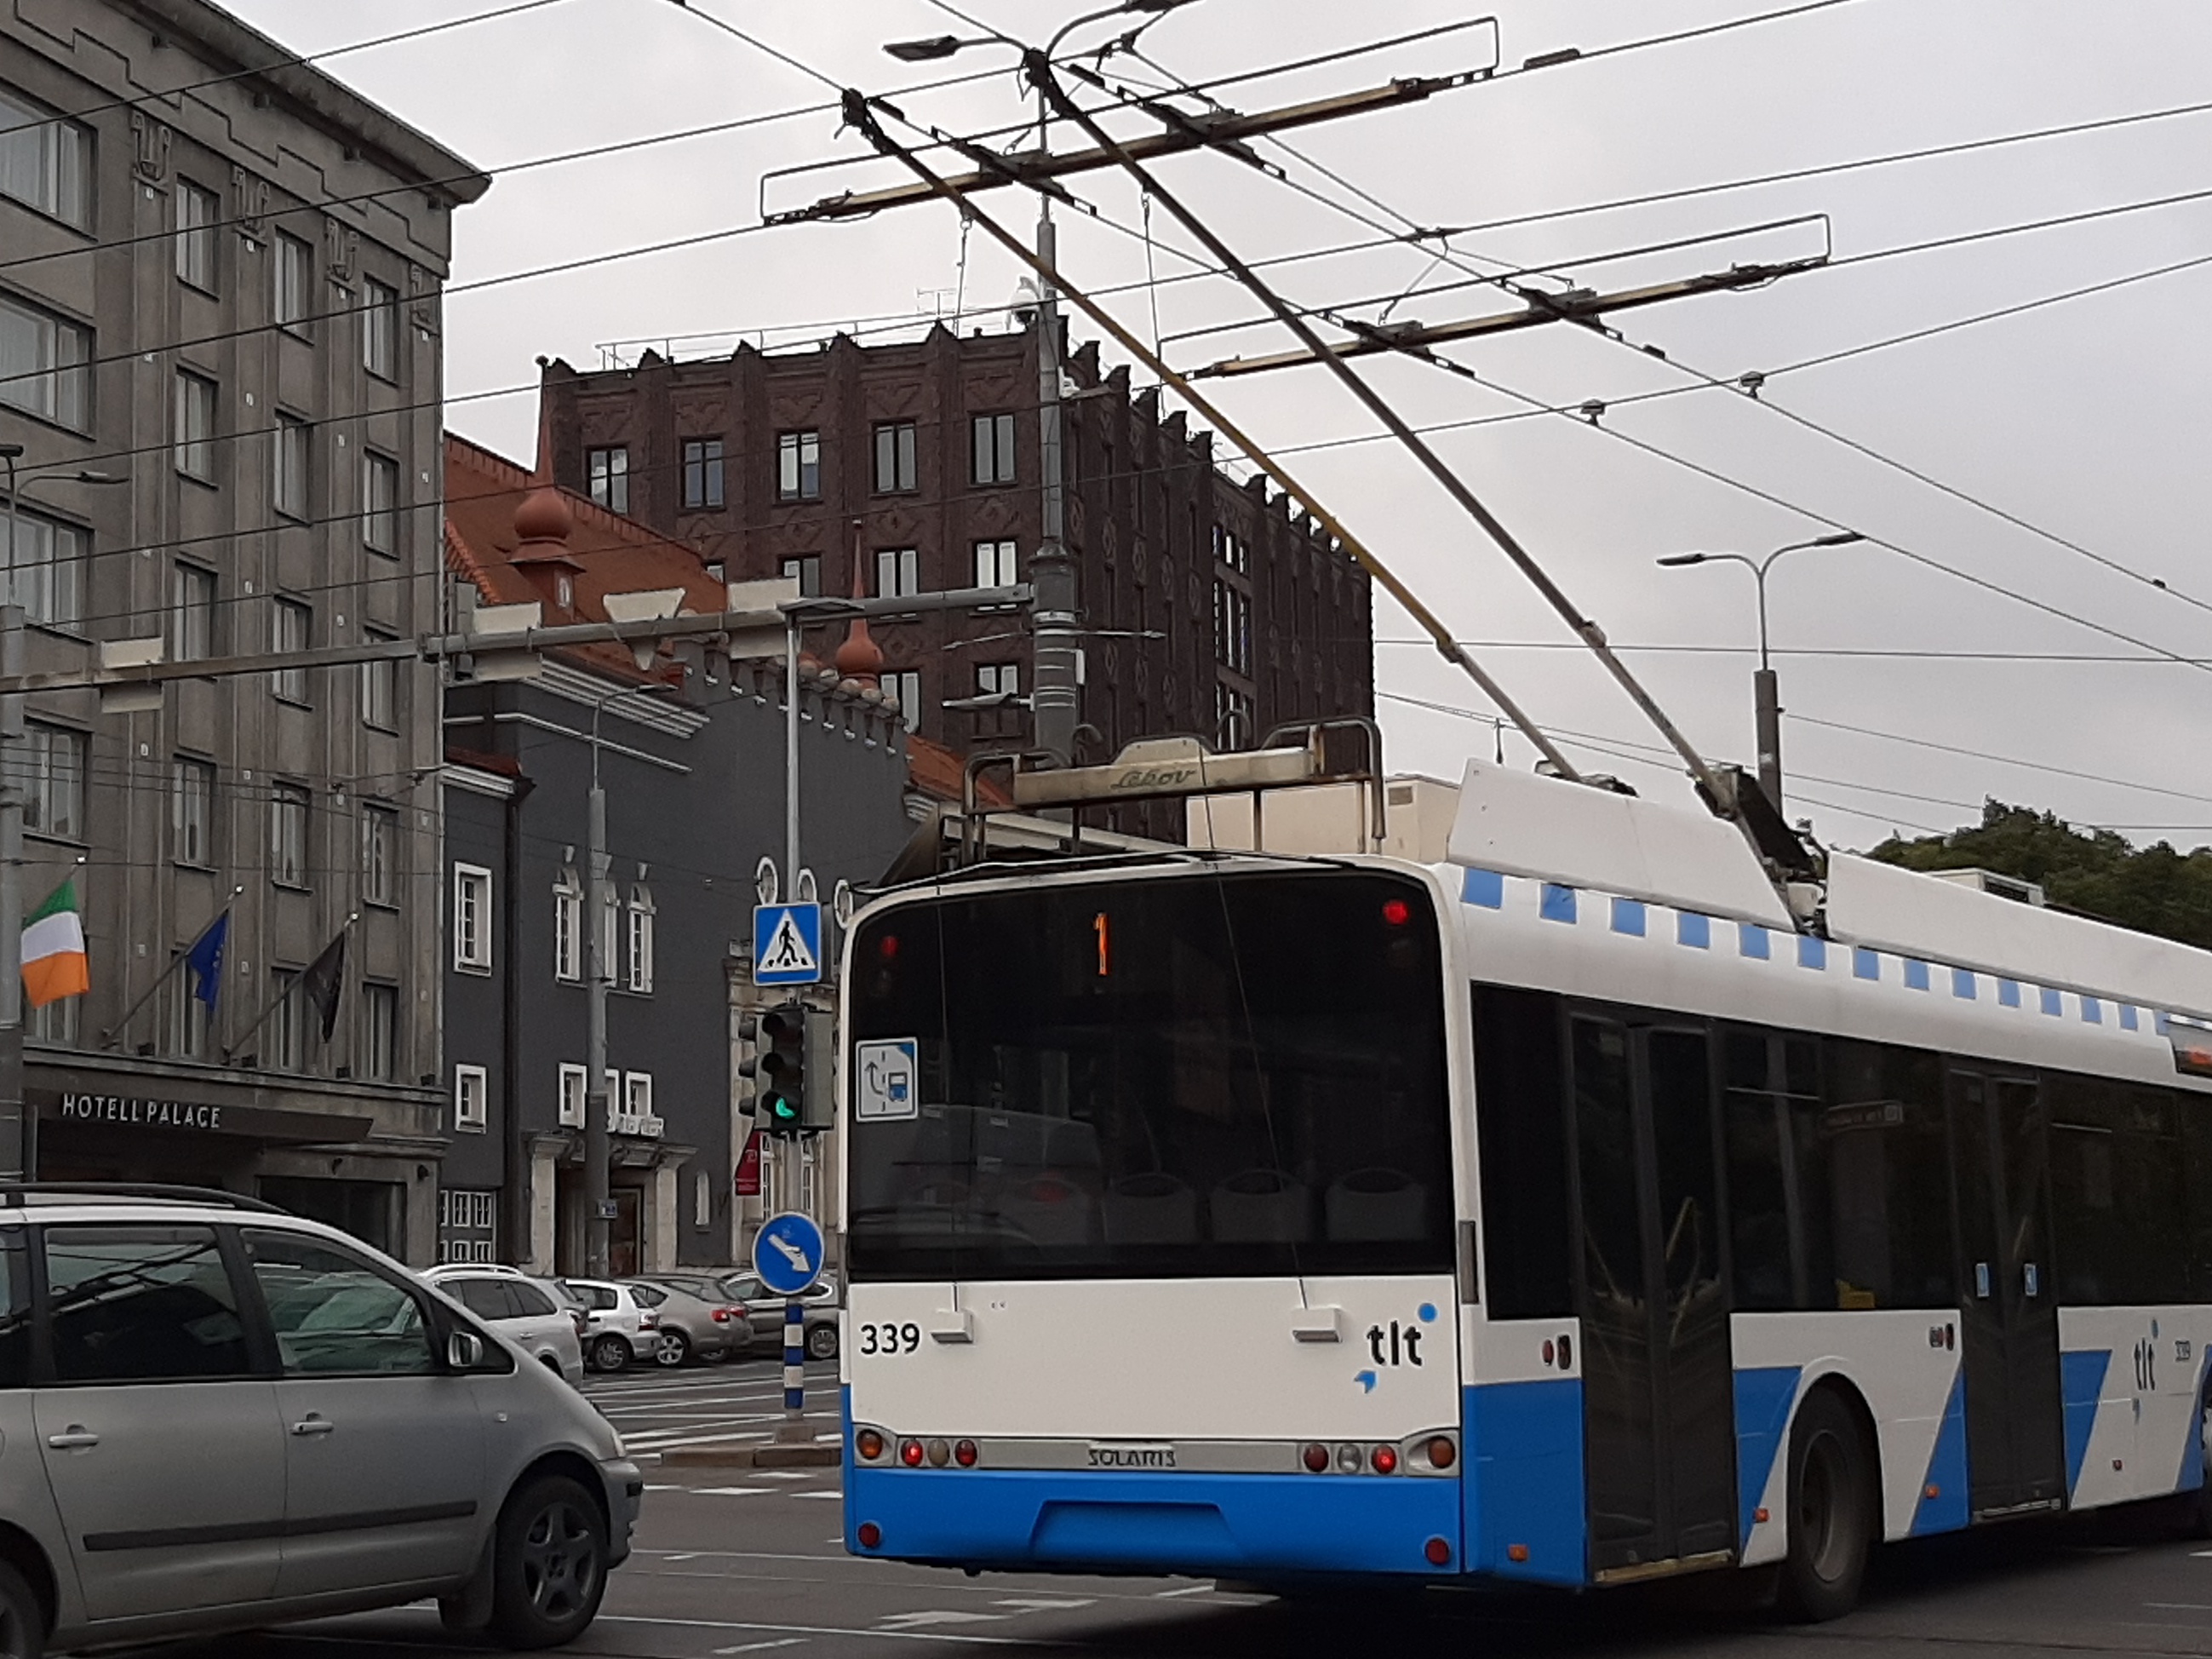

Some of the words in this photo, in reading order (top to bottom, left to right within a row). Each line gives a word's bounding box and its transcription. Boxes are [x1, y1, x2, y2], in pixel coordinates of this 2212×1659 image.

[1093, 913, 1109, 976] 1
[62, 1093, 140, 1122] HOTELL
[146, 1100, 221, 1128] PALACE
[860, 1323, 920, 1355] 339
[1366, 1319, 1423, 1366] tlt
[1087, 1449, 1177, 1467] SOLARIS
